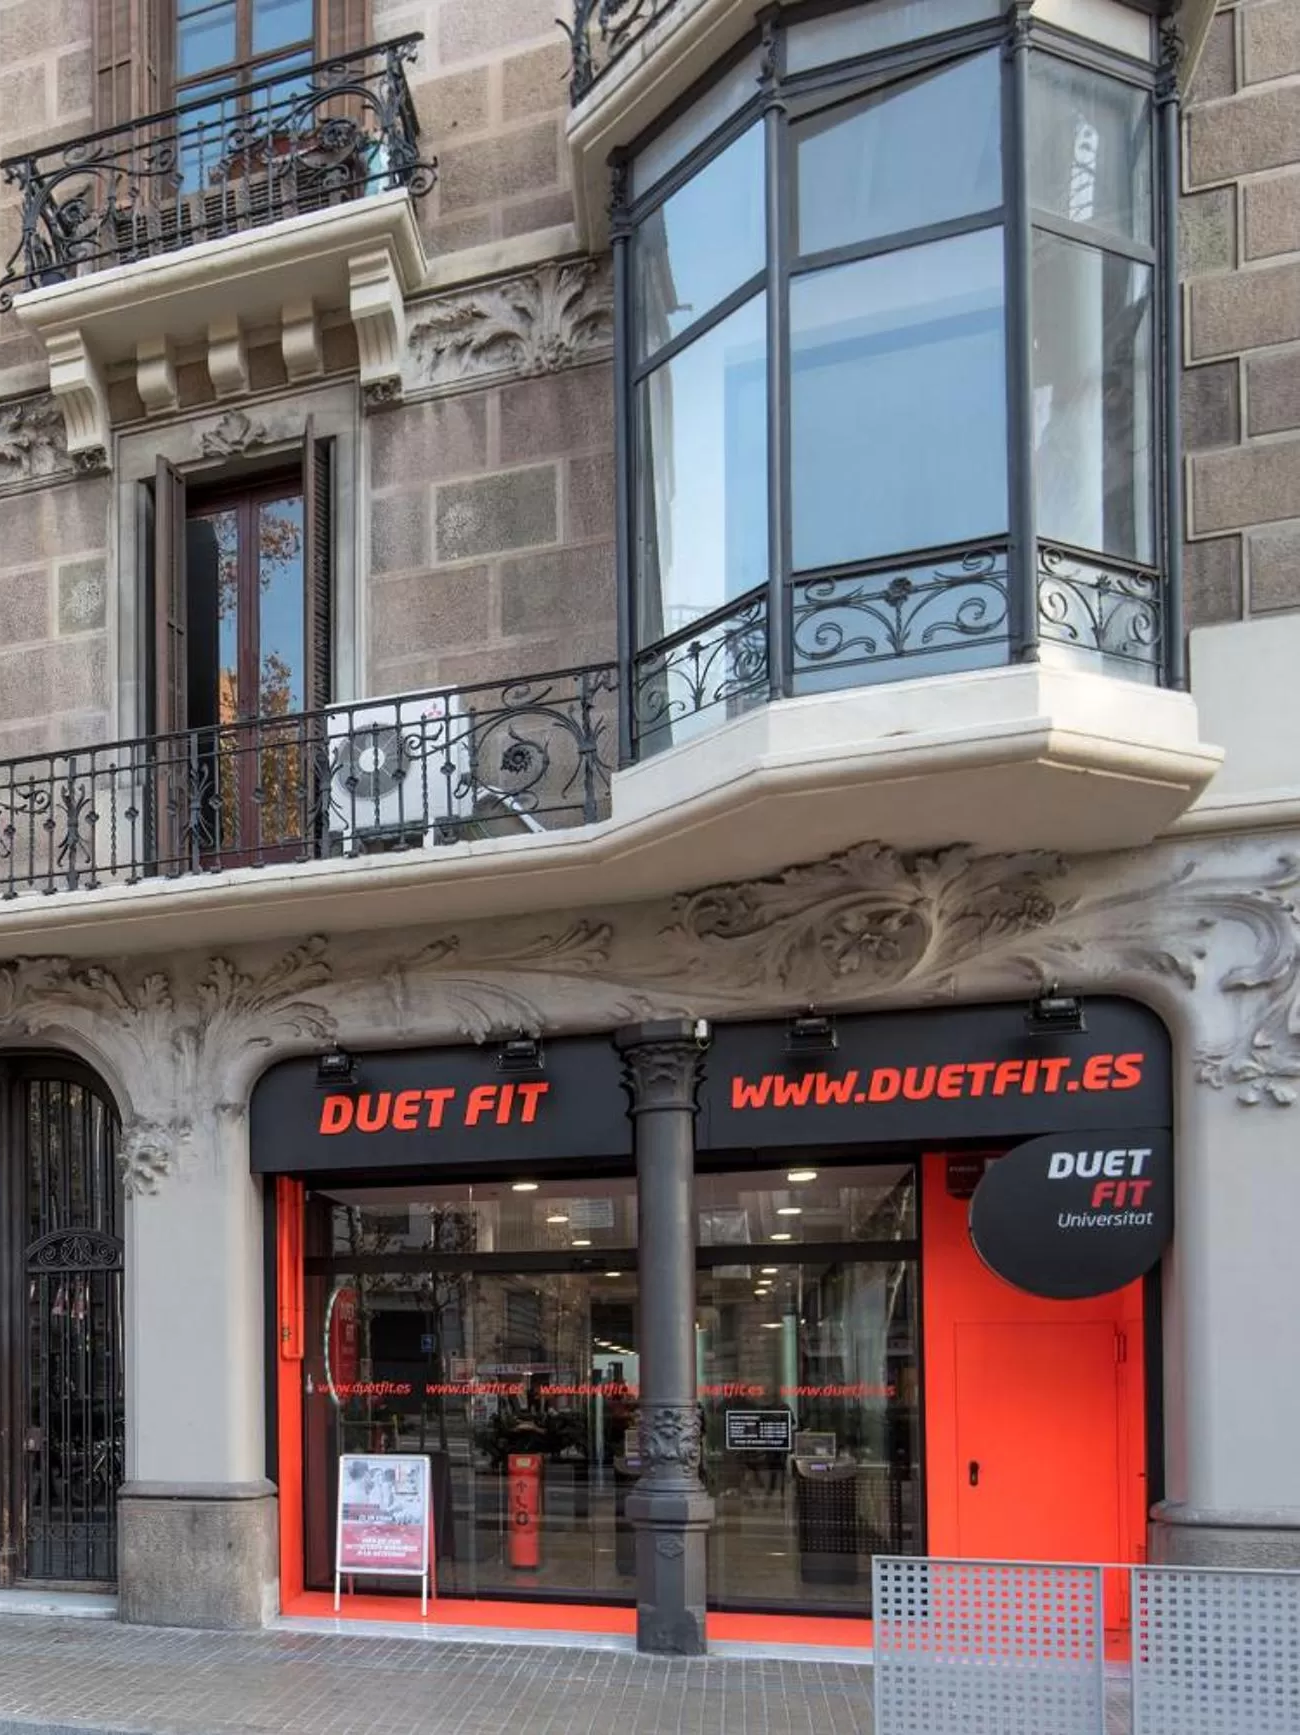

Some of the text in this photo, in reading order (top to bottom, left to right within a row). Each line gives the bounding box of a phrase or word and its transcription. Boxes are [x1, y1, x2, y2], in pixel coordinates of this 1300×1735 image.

[731, 1053, 1144, 1109] WWW.DUETFIT.ES
[318, 1082, 550, 1136] DUET FIT
[1047, 1148, 1153, 1179] DUET
[1091, 1180, 1153, 1208] FIT
[1058, 1211, 1154, 1228] Universitat
[318, 1381, 412, 1395] www.duetfit.es
[426, 1381, 524, 1395] www.duetfit.es
